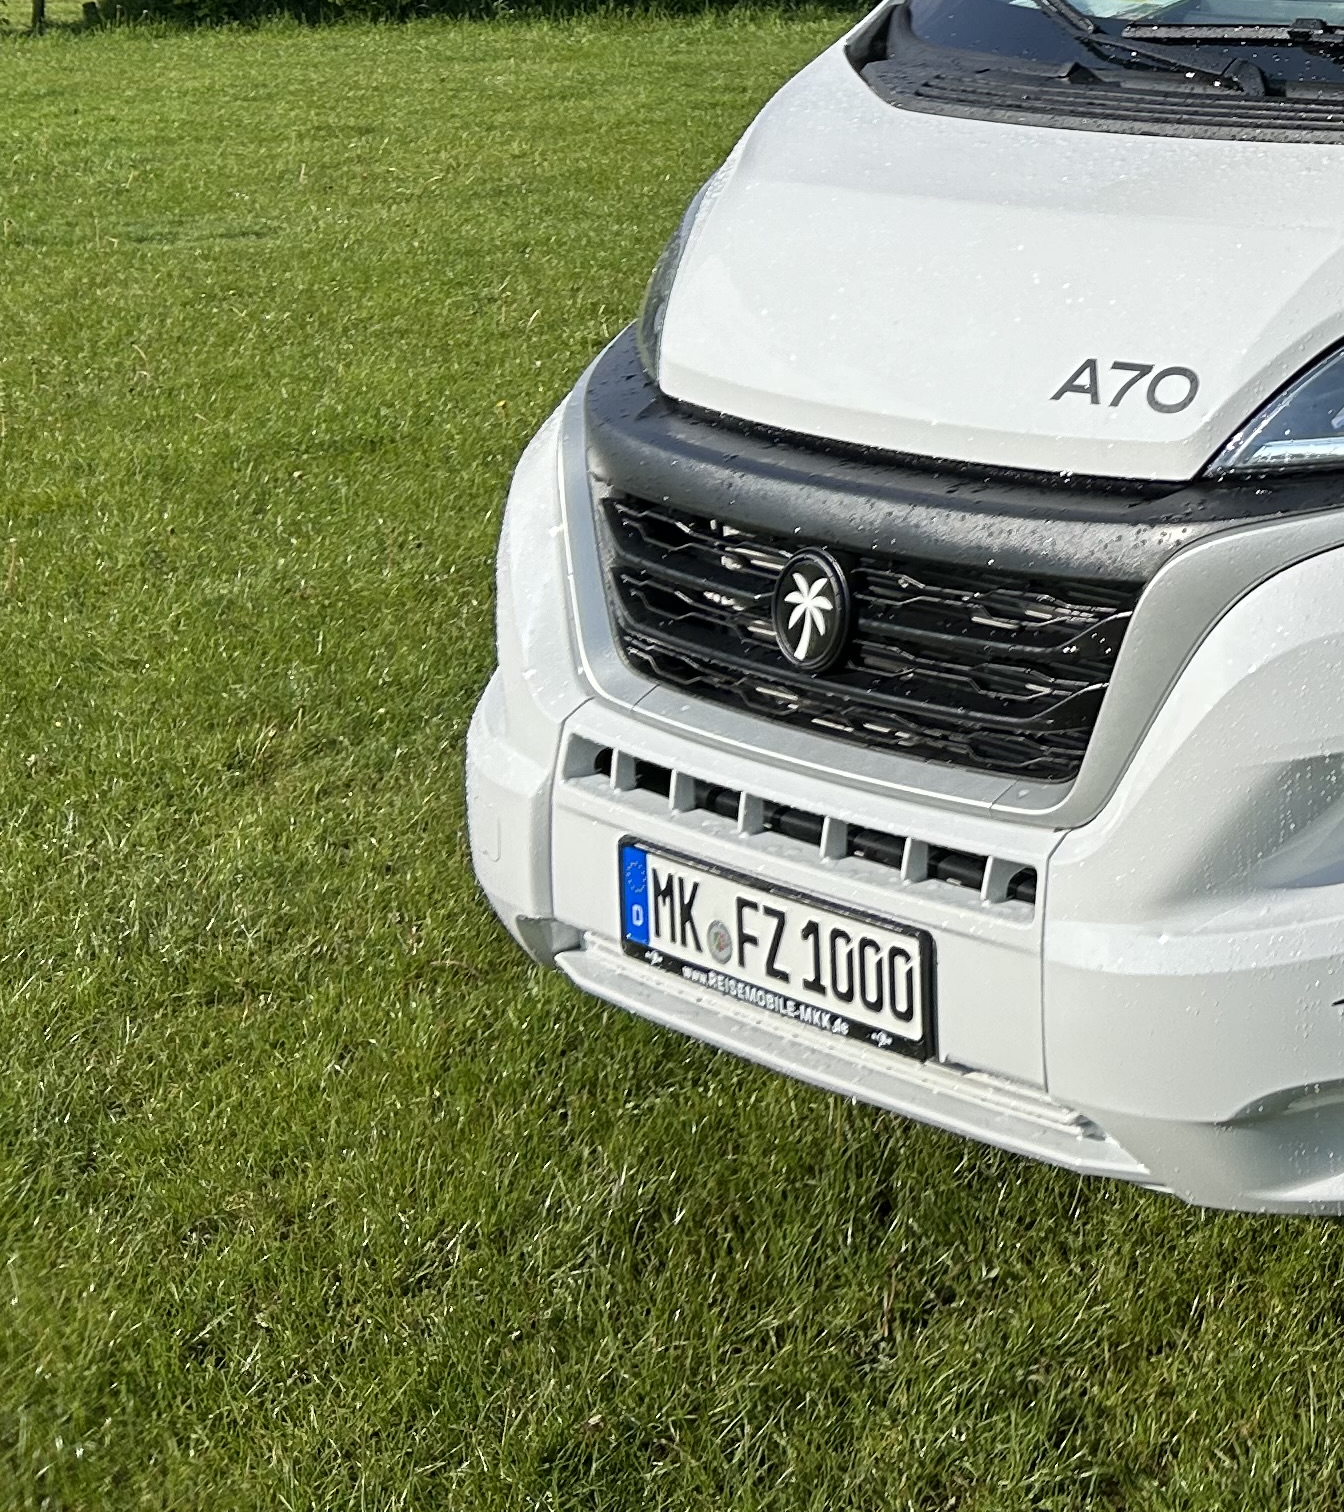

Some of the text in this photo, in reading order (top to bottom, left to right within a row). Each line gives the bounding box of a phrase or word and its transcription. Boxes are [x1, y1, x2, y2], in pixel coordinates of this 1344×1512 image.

[1049, 358, 1200, 414] A70
[632, 903, 644, 927] D
[652, 866, 703, 953] MK
